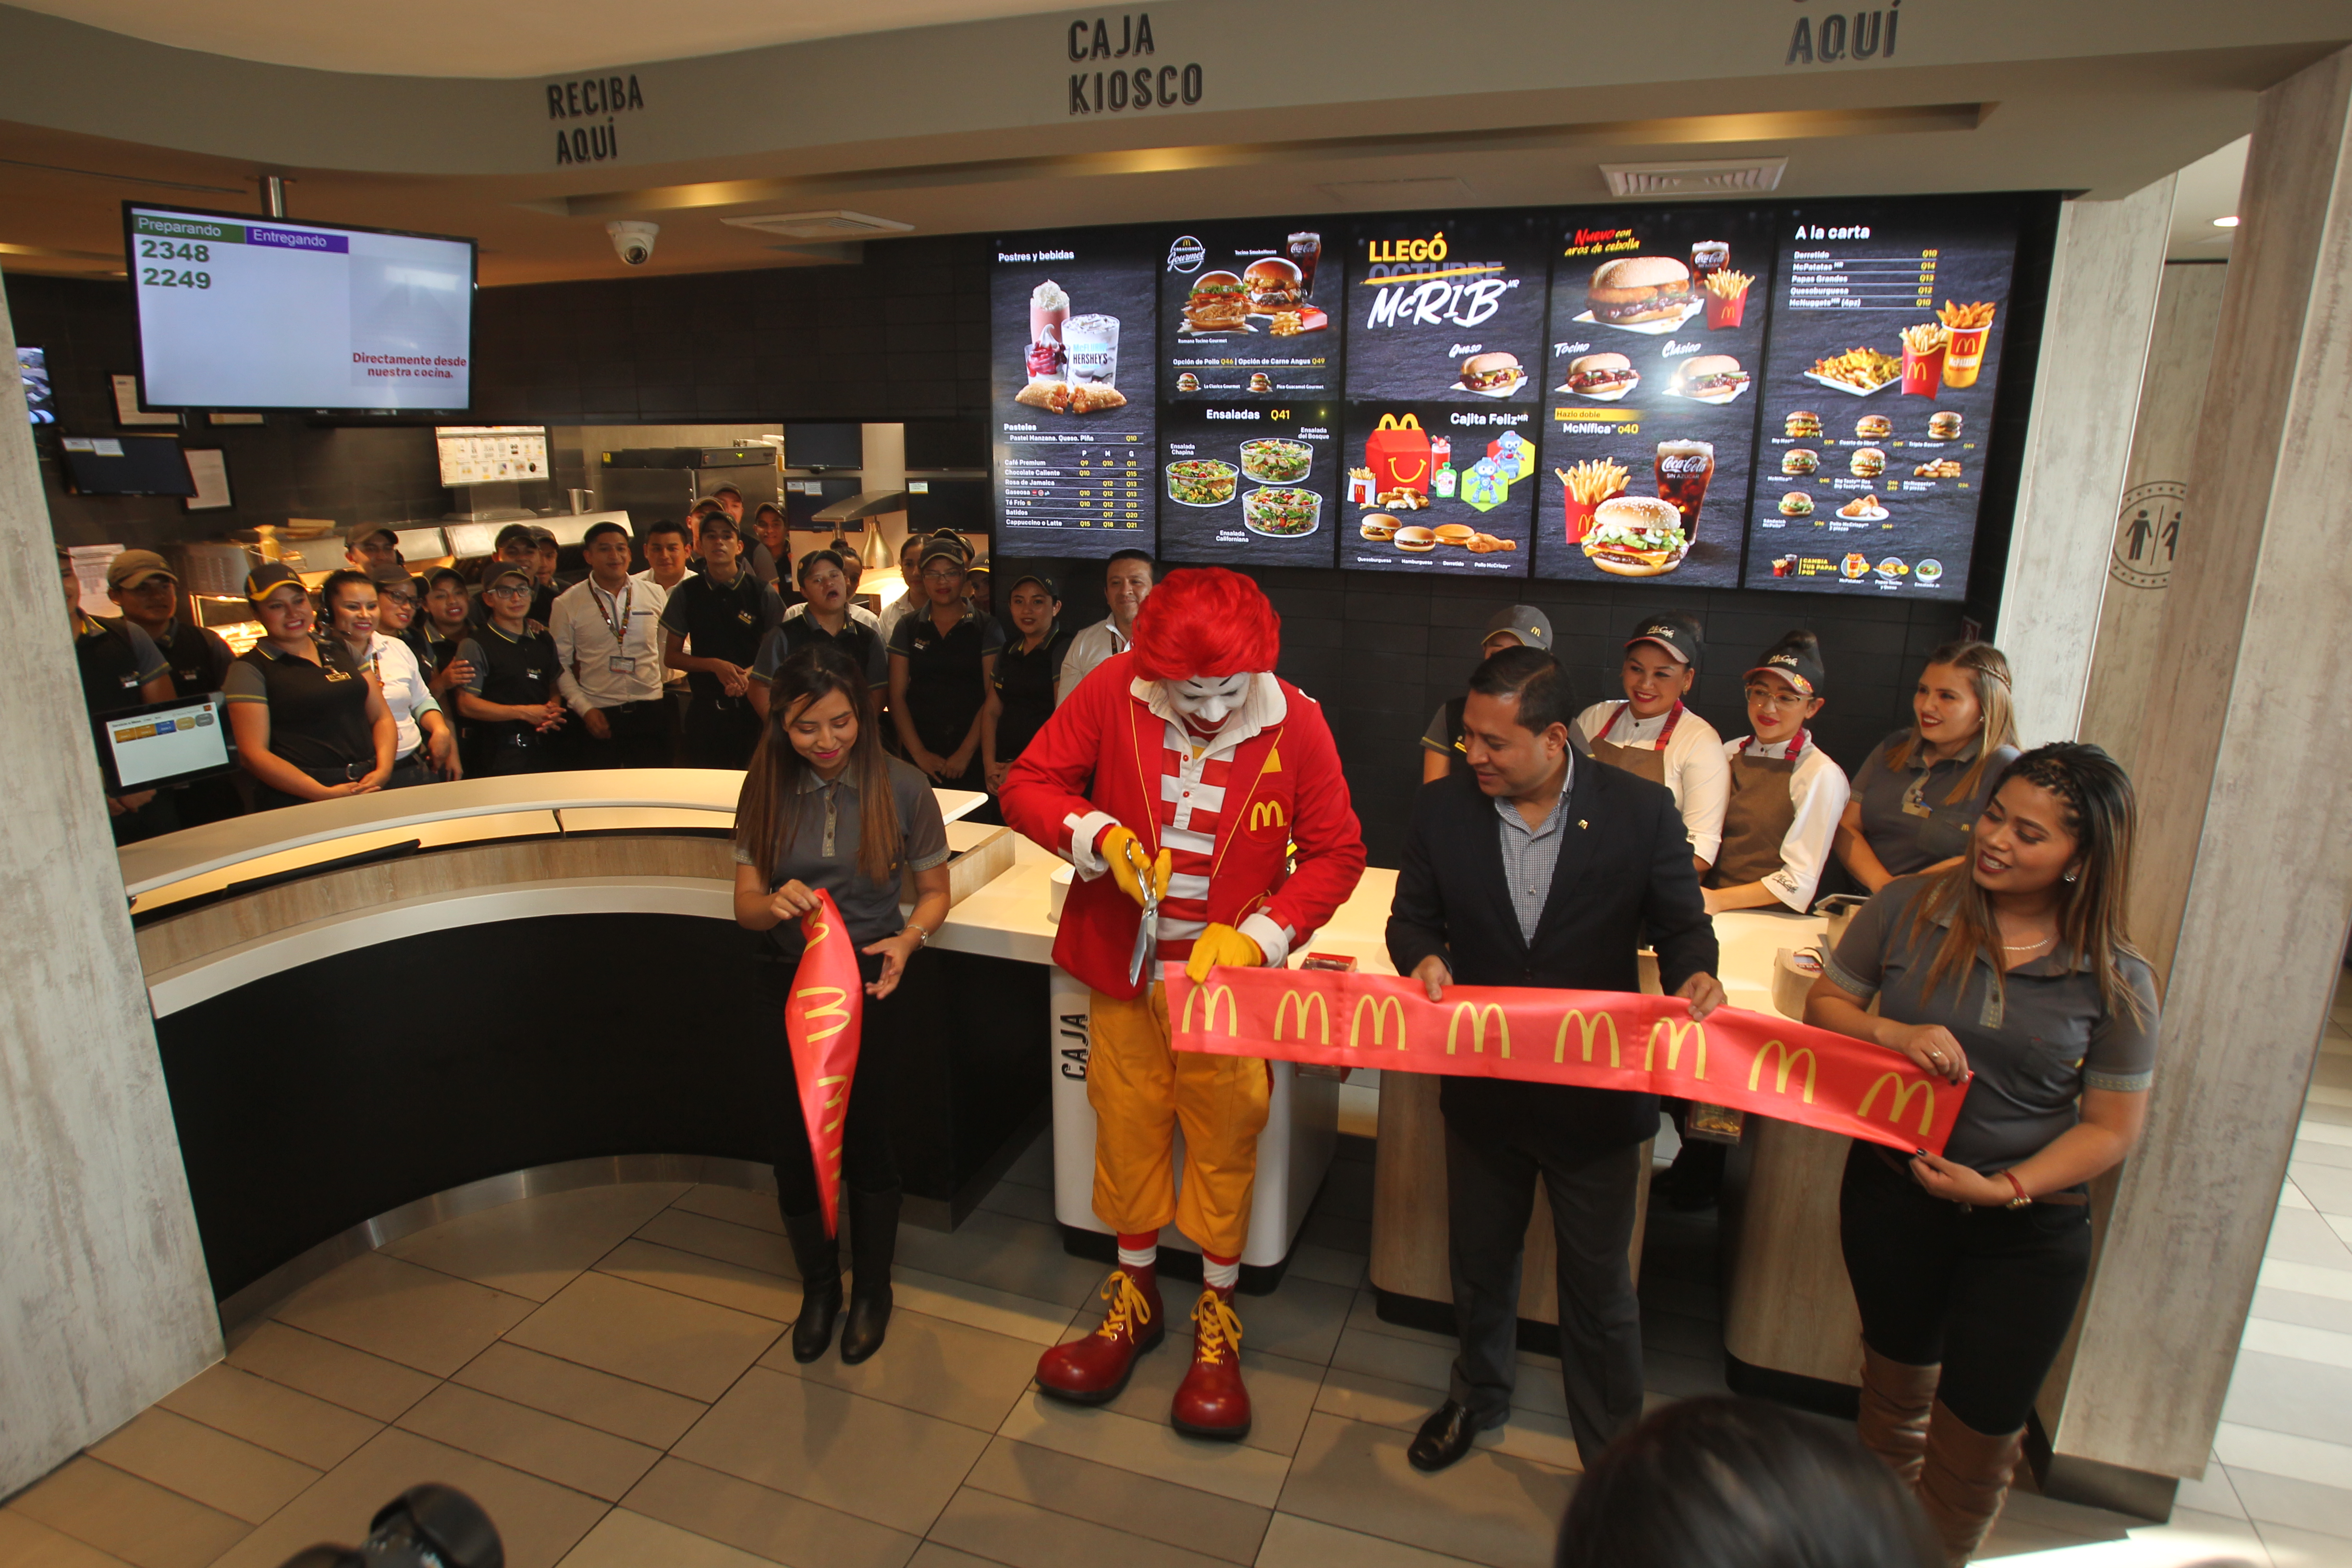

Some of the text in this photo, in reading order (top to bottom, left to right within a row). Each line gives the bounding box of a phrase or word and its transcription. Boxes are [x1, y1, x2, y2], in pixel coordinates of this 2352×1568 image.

[1068, 13, 1155, 61] CAJA
[1069, 62, 1202, 114] KIOSCO
[547, 74, 644, 119] RECIBA
[557, 116, 617, 164] AQUÍ
[138, 217, 221, 239] Preparando
[1616, 228, 1631, 239] con
[1795, 225, 1870, 240] A la carta
[254, 229, 326, 248] Entregando
[141, 240, 209, 262] 2348
[1369, 232, 1447, 261] LLEGÓ
[1564, 239, 1640, 257] aros de cebolla
[1794, 249, 1938, 259] Derretido Q10
[999, 250, 1075, 262] Postres y bebidas
[1167, 248, 1205, 272] Gourmet
[1793, 263, 1833, 271] McPatatas
[1921, 262, 1936, 270] Q14
[143, 267, 211, 289] 2249
[1791, 275, 1815, 283] Papas
[1816, 275, 1848, 283] Grandes
[1790, 287, 1849, 296] Quesoburguesa
[1841, 298, 1861, 308] (4pz)
[1448, 343, 1482, 358] Queso
[1554, 342, 1590, 357] Tocino
[1662, 340, 1702, 358] Clásico
[353, 353, 466, 367] Directamente desde
[1073, 353, 1107, 364] HERSHEY'S
[368, 366, 453, 379] nuestra cocina.
[1206, 409, 1290, 421] Ensaladas Q41
[1451, 413, 1486, 427] Cajita
[1060, 1013, 1088, 1081] CAJA
